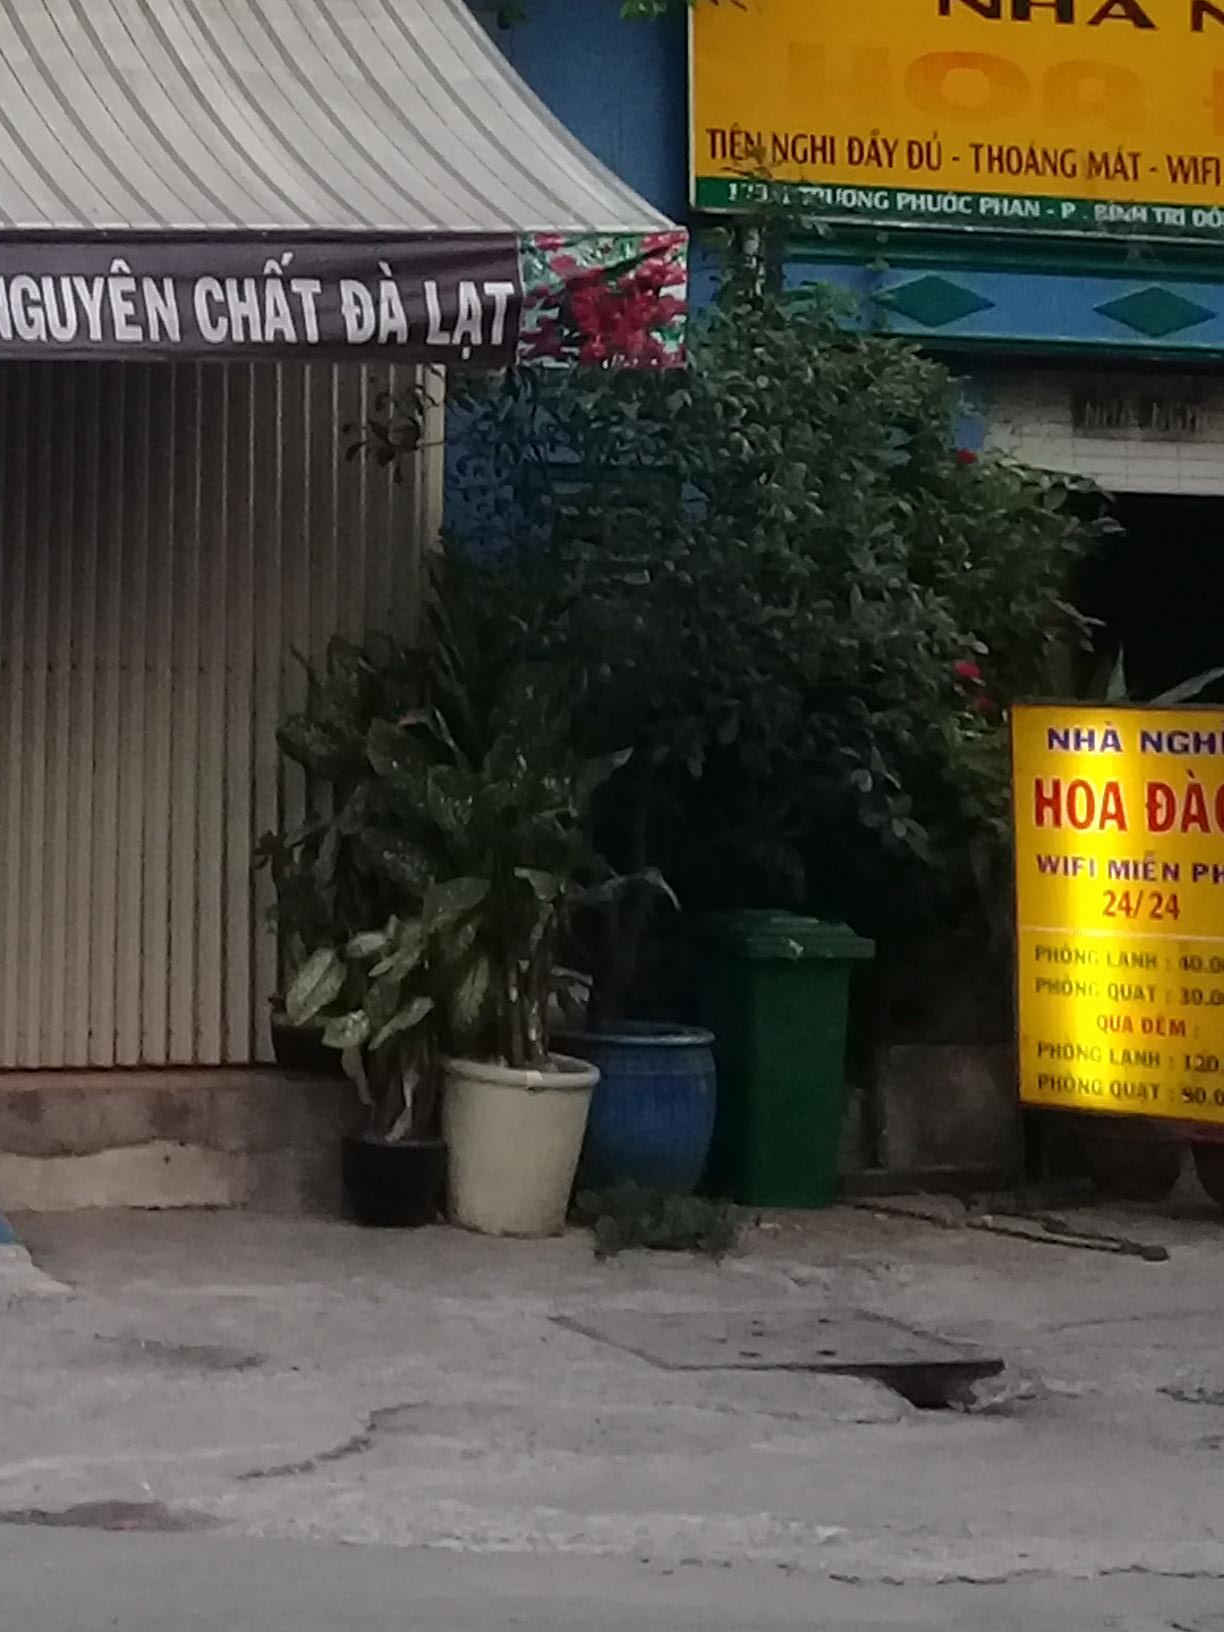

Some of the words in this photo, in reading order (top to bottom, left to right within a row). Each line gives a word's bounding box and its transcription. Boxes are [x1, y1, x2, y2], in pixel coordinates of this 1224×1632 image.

[771, 131, 836, 166] NGHI
[969, 140, 1077, 179] THOÁNG
[1087, 146, 1141, 181] MÁT
[1166, 155, 1221, 186] WIFI
[979, 197, 1040, 217] PHAN
[194, 252, 322, 343] CHẤT
[340, 261, 408, 343] ĐÀ
[426, 281, 516, 359] LẠT
[1048, 721, 1122, 752] NHÀ
[1035, 778, 1128, 832] HOA
[1145, 768, 1224, 833] ĐÀ
[1036, 854, 1096, 877] WIFI
